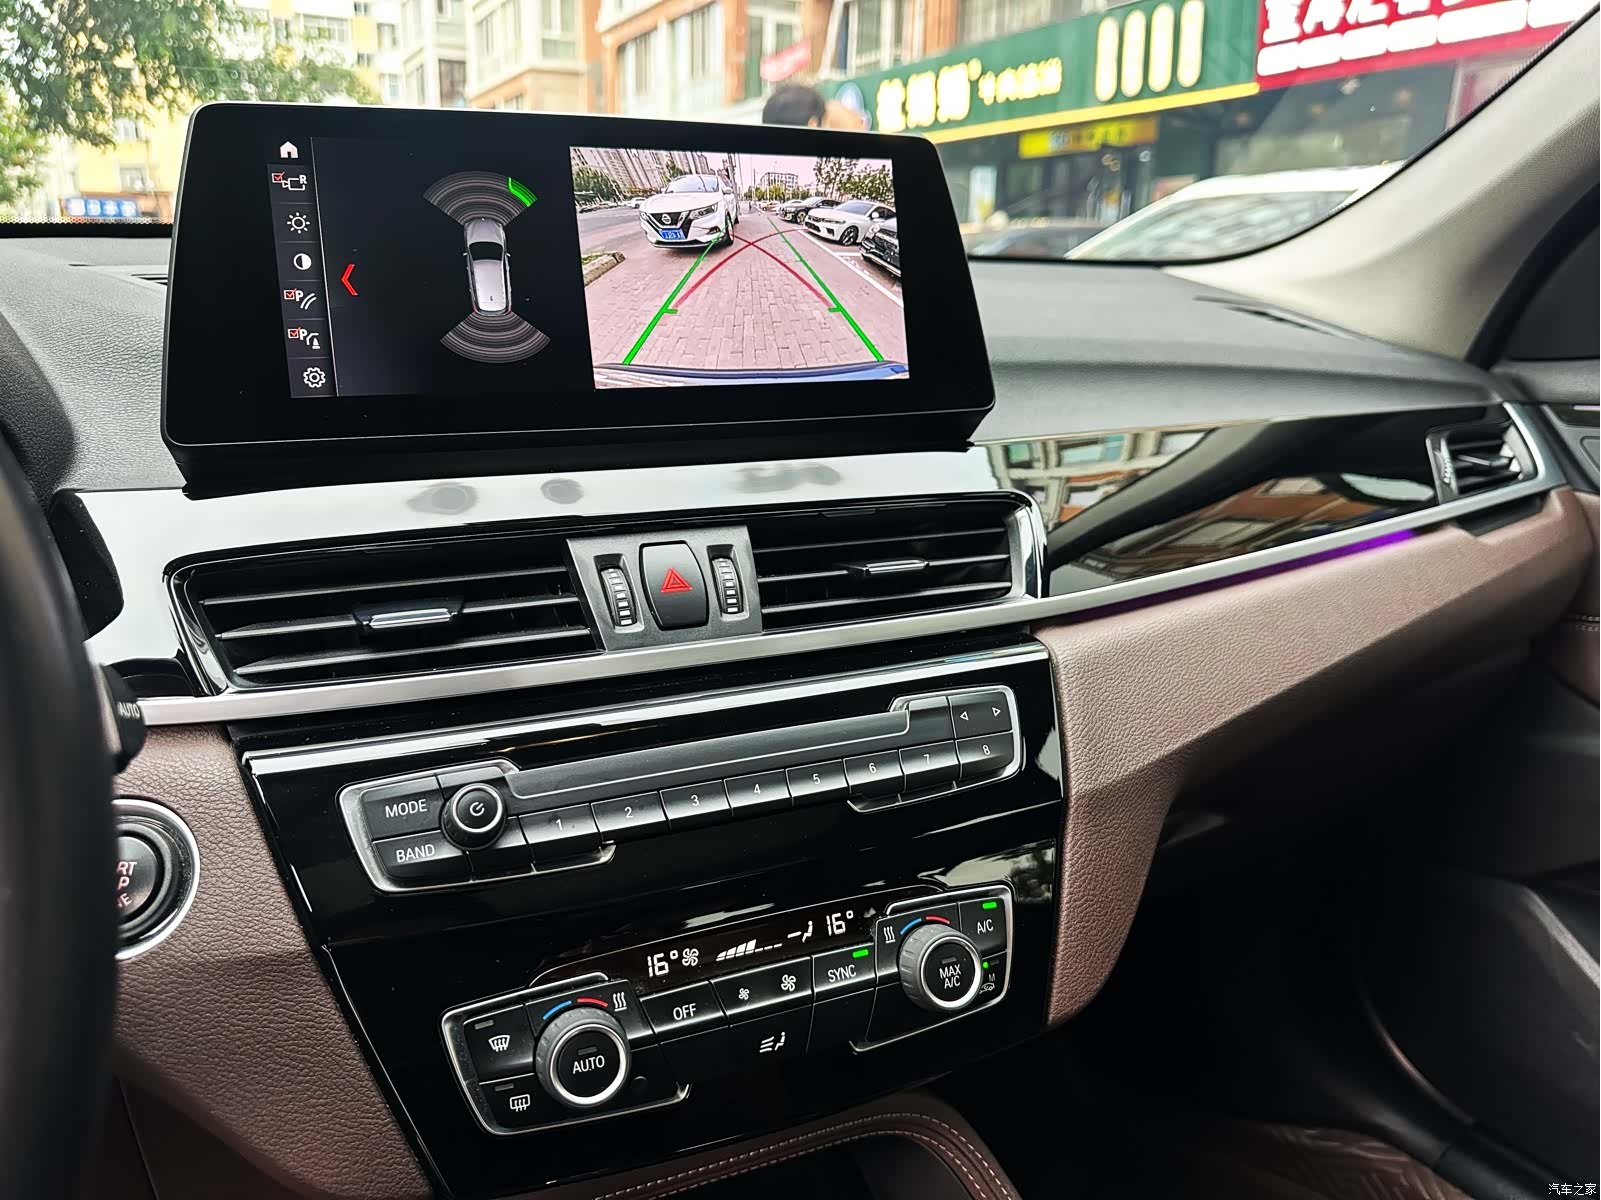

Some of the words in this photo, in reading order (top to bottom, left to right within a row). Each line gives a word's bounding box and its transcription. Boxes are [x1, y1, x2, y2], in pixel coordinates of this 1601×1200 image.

[299, 174, 308, 185] R
[295, 290, 304, 301] P
[299, 328, 308, 340] P
[117, 701, 141, 719] AUTO
[555, 817, 564, 831] 1
[624, 805, 634, 820] 2
[690, 793, 700, 807] 3
[753, 782, 762, 796] 4
[812, 773, 821, 786] 5
[868, 761, 877, 774] 6
[923, 752, 931, 765] 7
[982, 743, 991, 757] 8
[384, 798, 428, 819] MODE
[395, 842, 436, 864] BAND
[977, 918, 994, 935] A/C
[827, 963, 857, 983] SYNC
[938, 962, 963, 980] MAX
[988, 972, 996, 983] M
[943, 975, 961, 990] A/C
[672, 1003, 698, 1022] OFF
[572, 1054, 606, 1075] AUTO
